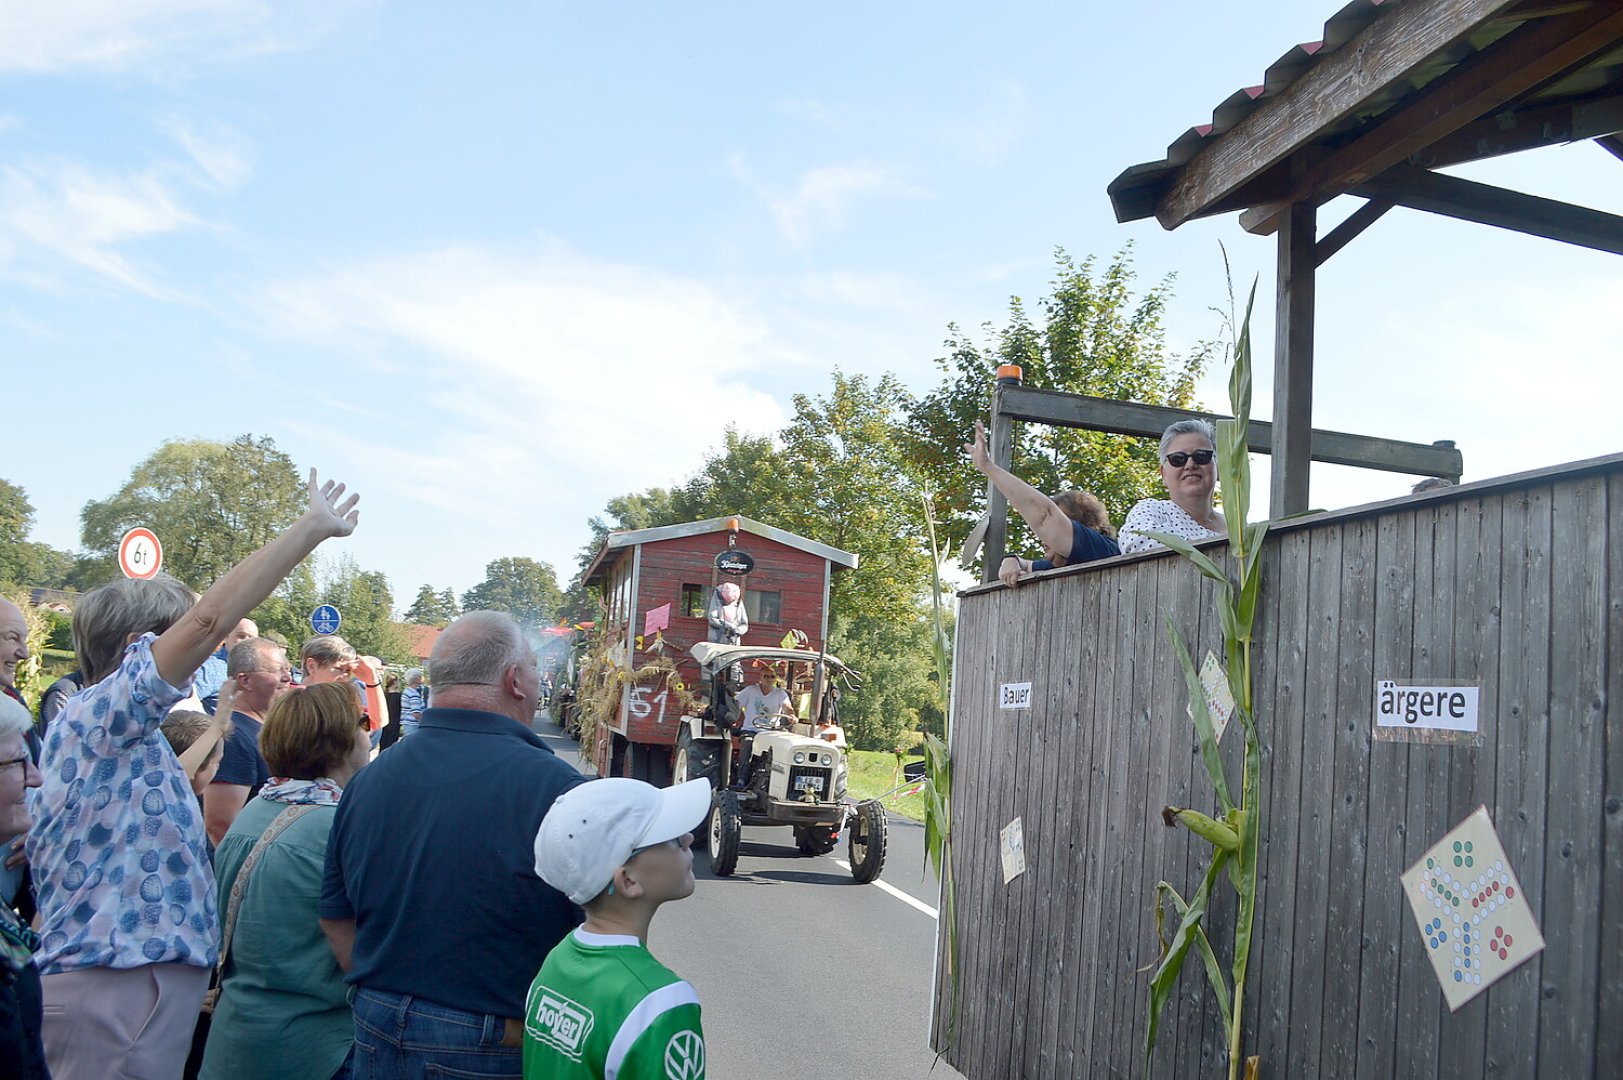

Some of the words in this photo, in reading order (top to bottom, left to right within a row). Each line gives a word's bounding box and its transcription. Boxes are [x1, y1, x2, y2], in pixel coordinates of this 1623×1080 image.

[1003, 686, 1030, 704] Bauer
[1381, 682, 1466, 724] ärgere
[535, 1001, 579, 1039] hoyer
